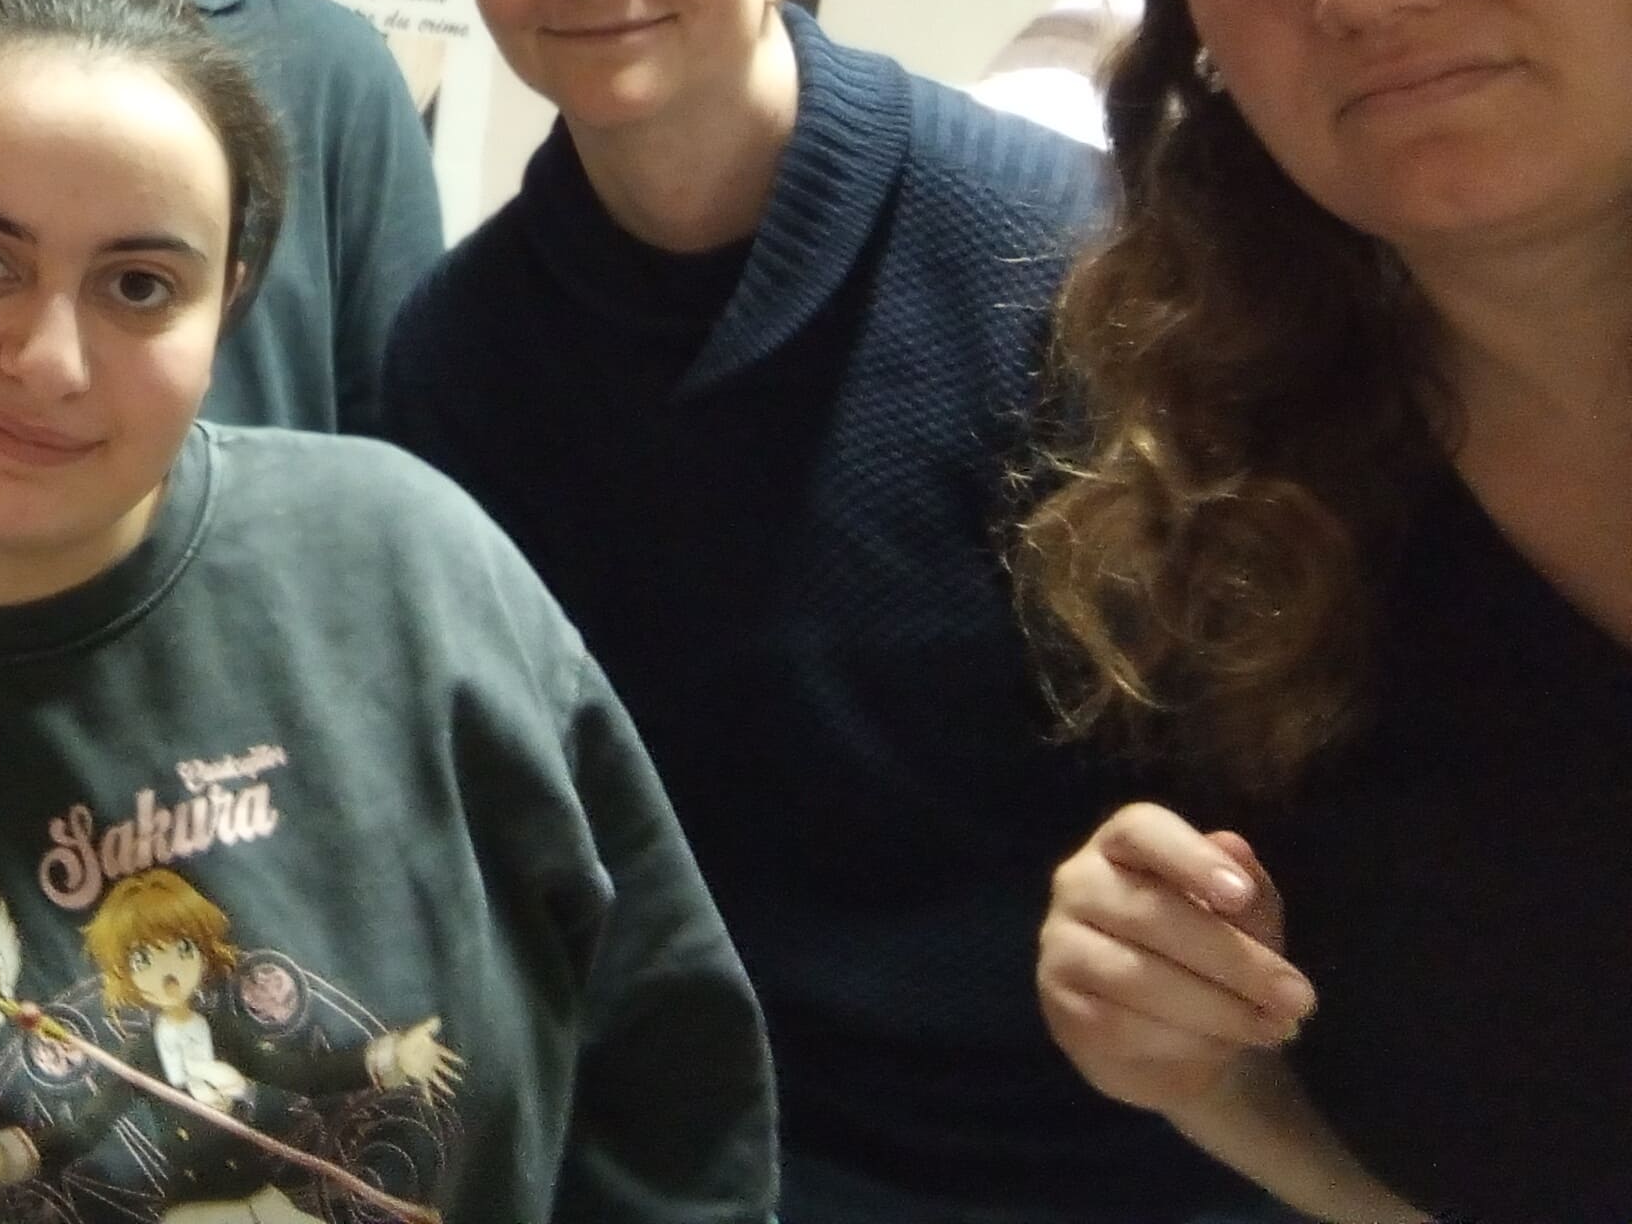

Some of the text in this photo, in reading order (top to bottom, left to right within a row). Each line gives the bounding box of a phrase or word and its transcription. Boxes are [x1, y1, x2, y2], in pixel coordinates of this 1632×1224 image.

[384, 9, 409, 30] du
[418, 18, 470, 38] crime
[39, 783, 279, 911] Sakura
